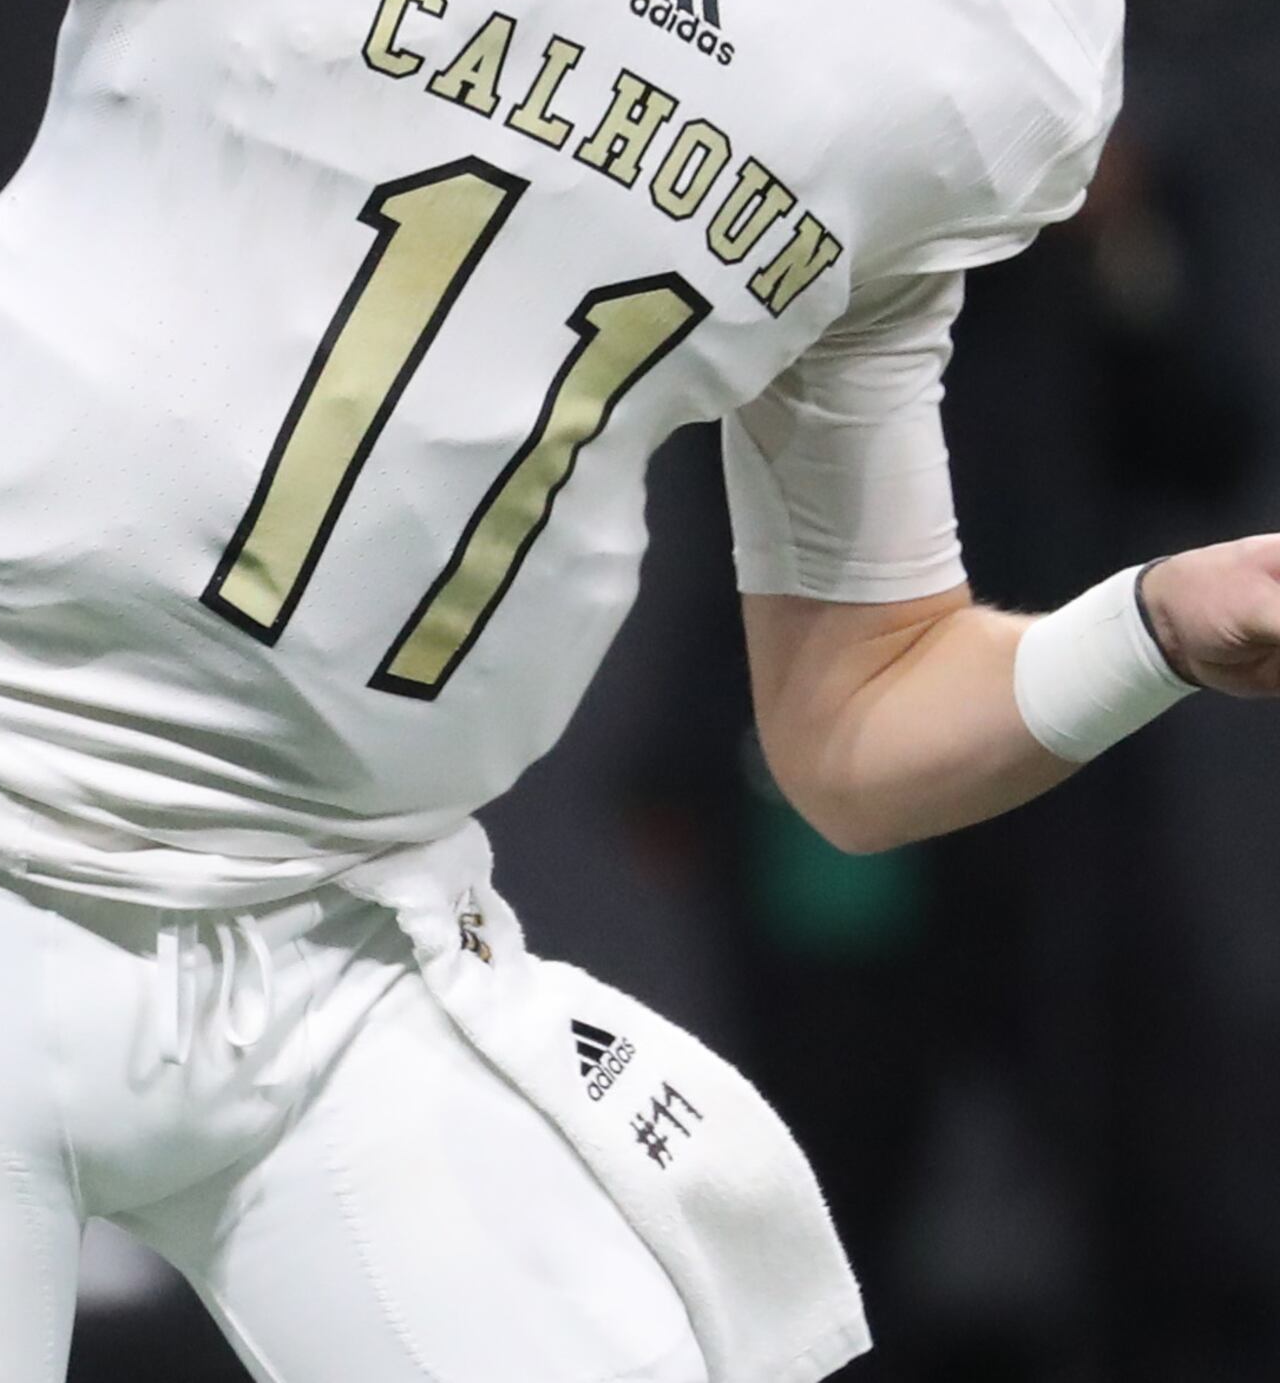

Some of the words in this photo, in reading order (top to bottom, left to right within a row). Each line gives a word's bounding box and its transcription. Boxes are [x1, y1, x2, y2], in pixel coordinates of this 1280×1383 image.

[199, 155, 714, 702] 11
[586, 1036, 637, 1103] adidas
[629, 1080, 704, 1170] #11
